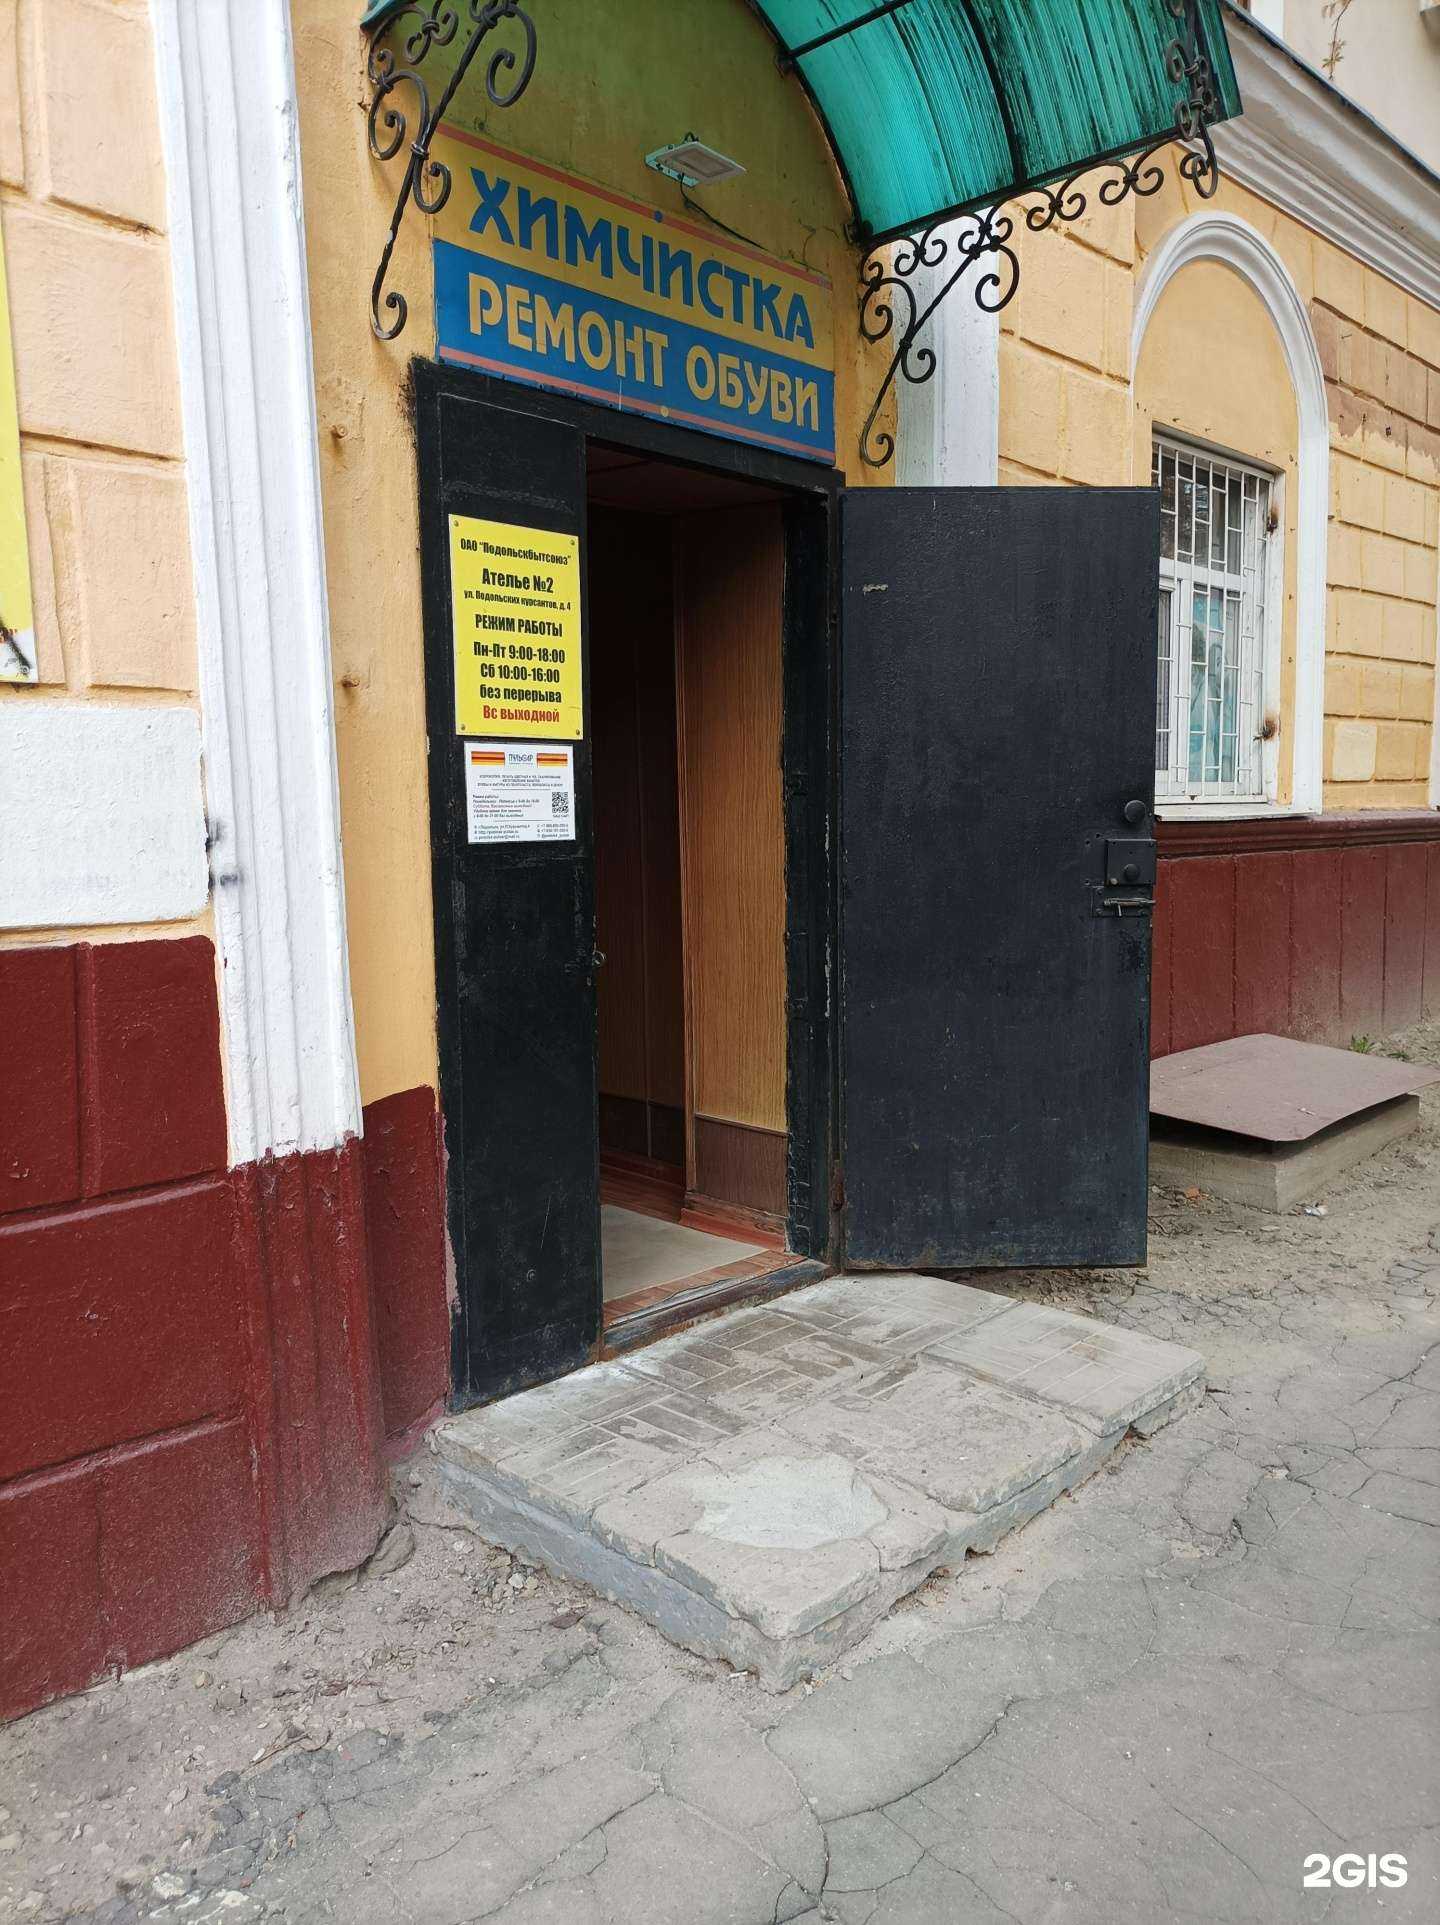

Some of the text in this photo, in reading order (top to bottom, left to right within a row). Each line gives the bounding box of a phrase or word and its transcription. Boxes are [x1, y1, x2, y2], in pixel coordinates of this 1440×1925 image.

[468, 167, 815, 350] ХИМЧИСТКА
[468, 272, 820, 433] РЕМОНТ ОБУВИ
[460, 538, 477, 551] ОАО
[482, 568, 554, 593] Ателье №2
[464, 590, 474, 599] ул.
[476, 591, 520, 604] Подольских
[475, 614, 563, 637] РЕЖИМ РАБОТЫ
[473, 641, 566, 663] Пн-Пт 9:00-18:00
[480, 663, 560, 683] Сб 10:00-16:00
[480, 684, 562, 703] без перерыва
[483, 705, 560, 723] Вс выходной
